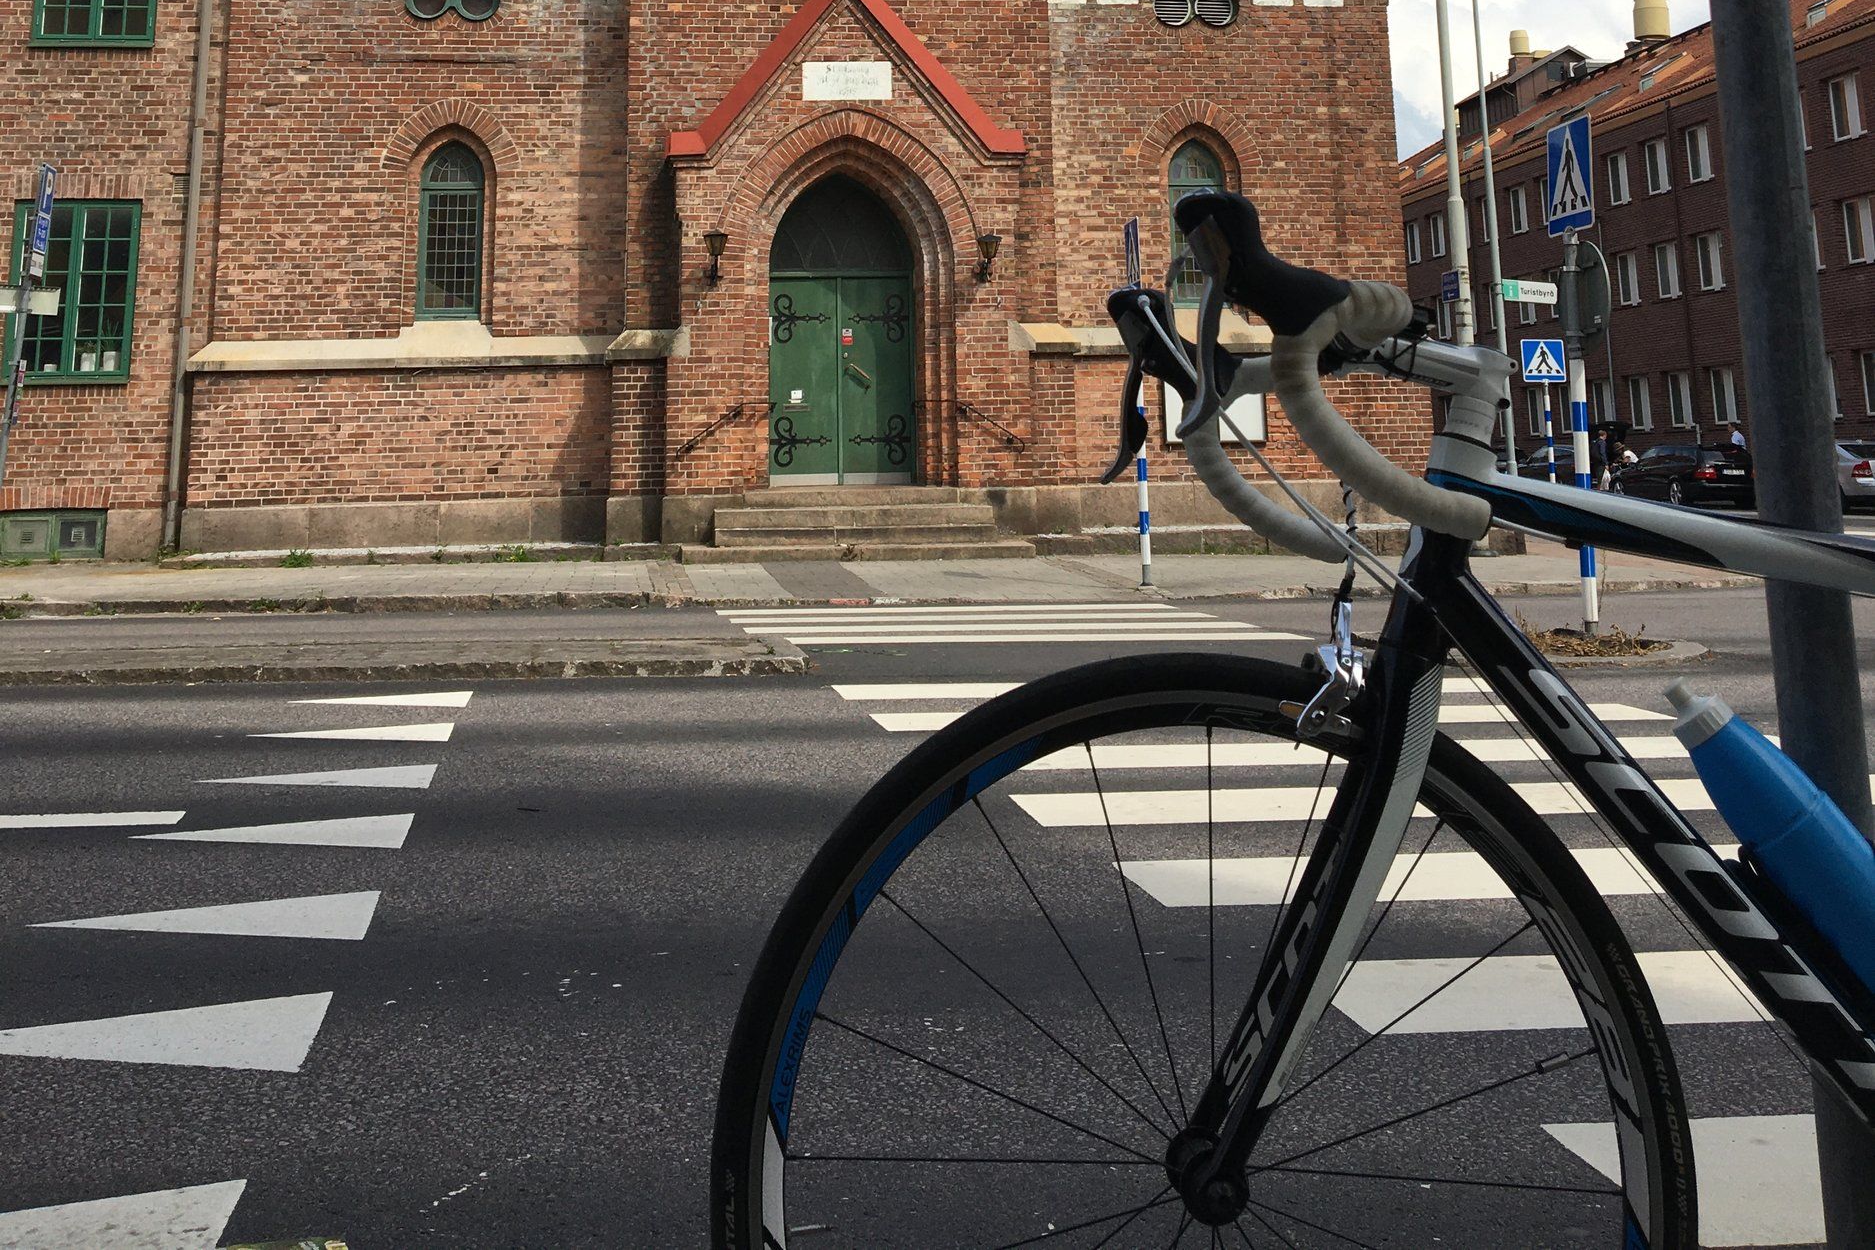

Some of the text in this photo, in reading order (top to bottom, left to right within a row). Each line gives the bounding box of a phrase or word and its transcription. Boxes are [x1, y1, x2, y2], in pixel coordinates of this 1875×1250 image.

[43, 171, 54, 209] P
[1520, 287, 1554, 298] Turistbyrå
[775, 1006, 811, 1115] ALEXRIMS
[1616, 963, 1655, 1039] GRAND
[1650, 1041, 1672, 1096] PRIX
